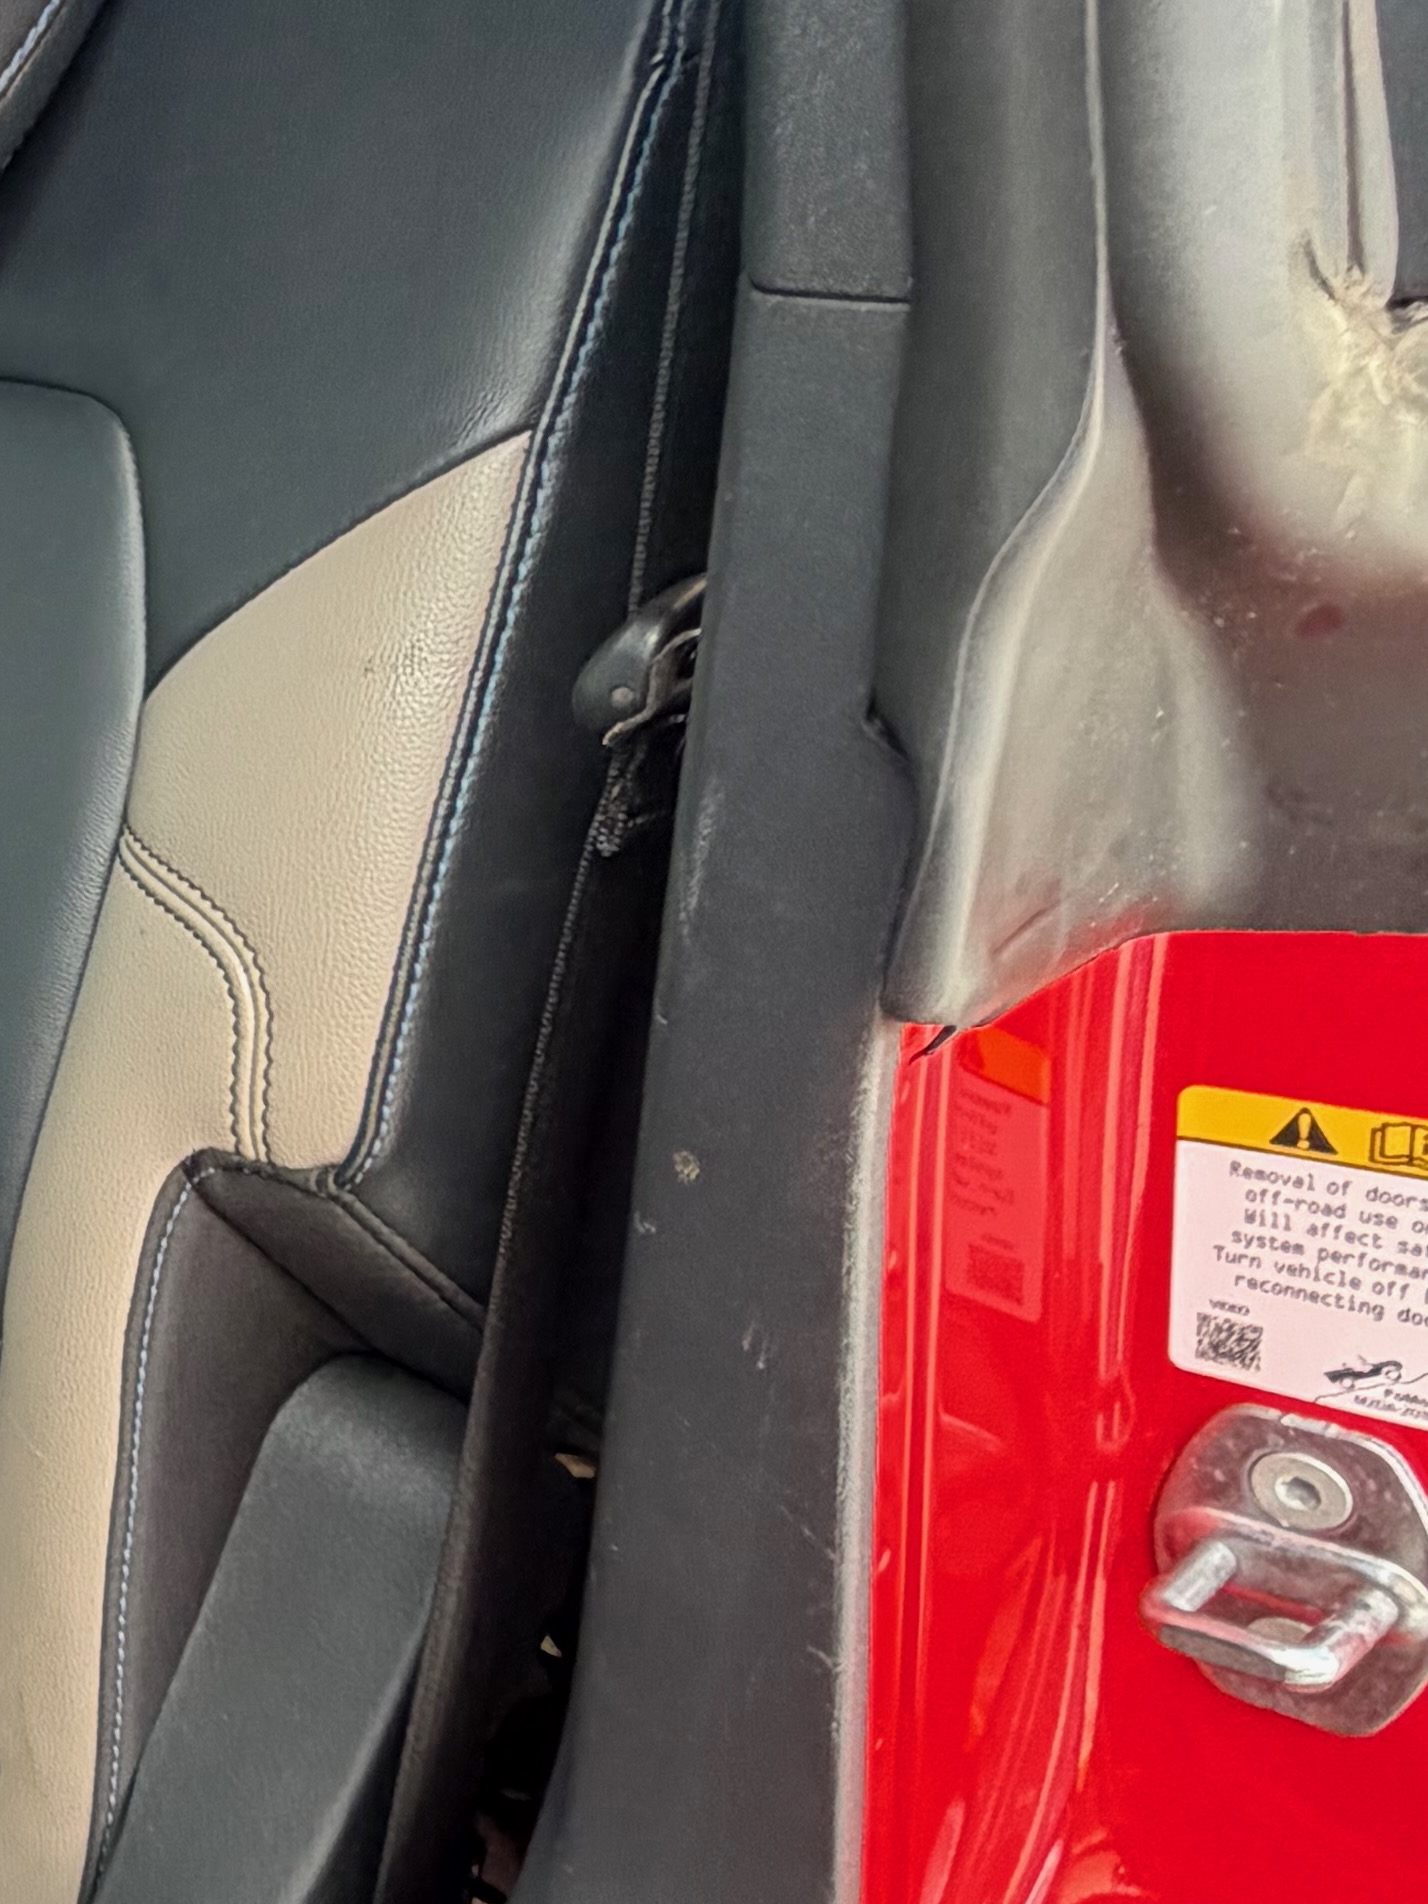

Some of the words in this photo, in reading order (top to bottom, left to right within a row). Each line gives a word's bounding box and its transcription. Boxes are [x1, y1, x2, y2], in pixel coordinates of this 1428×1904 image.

[1229, 1160, 1315, 1192] Removal
[1326, 1180, 1352, 1196] of
[1245, 1188, 1347, 1219] off-road
[1359, 1210, 1398, 1229] use
[1231, 1230, 1305, 1255] system
[1244, 1208, 1292, 1232] Will
[1306, 1222, 1383, 1249] affect
[1397, 1240, 1428, 1258] sa
[1213, 1245, 1262, 1269] Turn
[1274, 1260, 1362, 1290] vehicle
[1372, 1280, 1410, 1300] off
[1234, 1274, 1384, 1322] reconnecting
